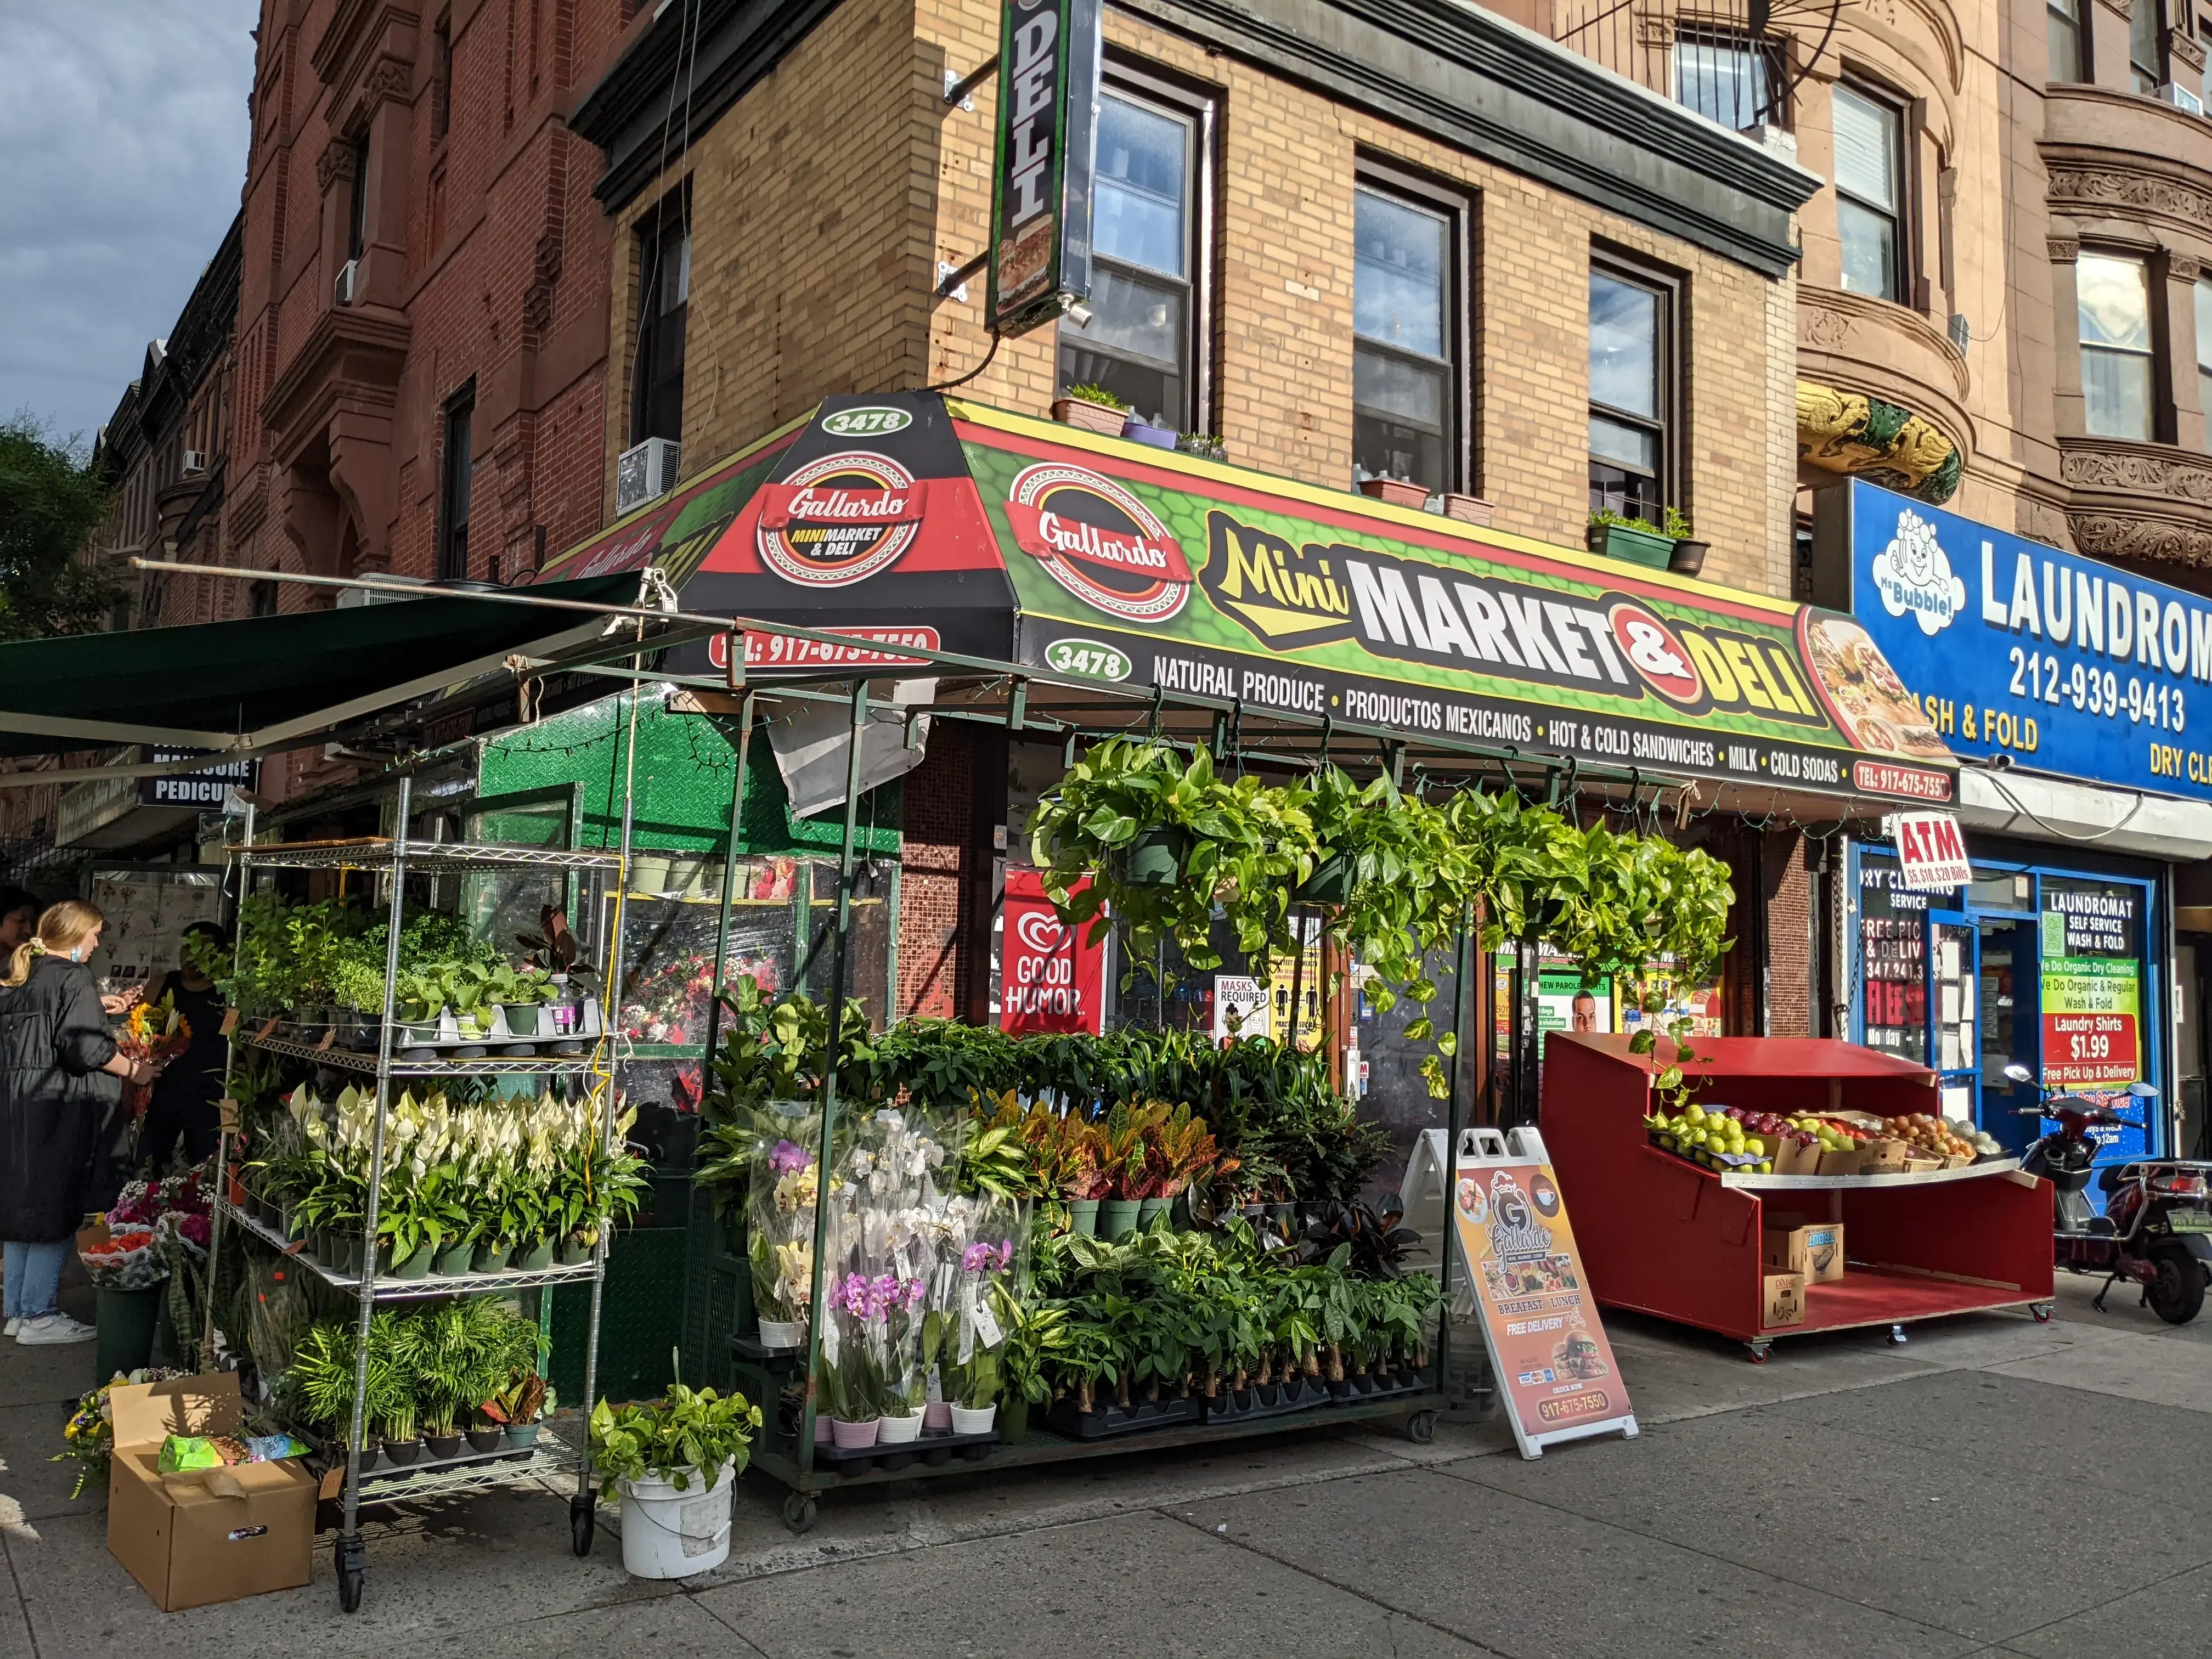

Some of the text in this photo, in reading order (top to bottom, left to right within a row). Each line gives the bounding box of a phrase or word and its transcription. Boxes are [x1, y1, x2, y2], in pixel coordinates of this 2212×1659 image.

[1012, 10, 1058, 228] DELI
[832, 409, 900, 432] 3478
[788, 486, 909, 522] Gallardo
[810, 541, 856, 557] & DELI
[1038, 512, 1167, 569] Gallardo
[1881, 576, 1892, 589] Ms
[1893, 581, 1952, 621] Bubble!
[1981, 540, 2212, 680] LAUNDROM
[1217, 527, 1818, 718] Mini MARKET & DELI
[720, 634, 763, 663] TL:
[1054, 646, 1121, 678] 3478
[2009, 647, 2185, 733] 212-939-9413
[1154, 656, 1838, 784] NATURAL PRODUCE PRODUCTOS MEXICANOS HOT & COLD SANDWICHES MILK COLD SODAS
[1913, 693, 2038, 752] SH & FOLD
[2150, 743, 2183, 778] DRY
[1859, 766, 1878, 788] TEL:
[156, 780, 245, 802] PEDICUR
[1901, 820, 1964, 864] ATM
[1951, 866, 1969, 880] Bills
[1890, 893, 1927, 910] SERVICE
[2051, 893, 2133, 918] LAUNDROMAT
[1861, 919, 1921, 940] REE PIC
[2069, 916, 2123, 933] SELF SERVICE
[1866, 940, 1876, 958] &
[2067, 932, 2125, 950] WASH & FOLD
[1017, 956, 1072, 985] GOOD
[2051, 962, 2062, 972] Do
[2064, 961, 2091, 974] Organic
[2092, 962, 2104, 975] Dry
[2106, 962, 2135, 975] Cleaning
[1221, 980, 1252, 991] MASKS
[1538, 981, 1554, 990] NEW
[1555, 982, 1581, 990] PAROLE
[2053, 979, 2065, 991] Do
[2067, 979, 2098, 994] Organic
[2100, 980, 2106, 992] &
[2107, 980, 2136, 995] Regular
[1221, 991, 1266, 1003] REQUIRED
[2064, 996, 2113, 1009] Wash & Fold
[2055, 1016, 2123, 1035] Laundry Shirts
[1867, 1029, 1900, 1047] Monday
[2070, 1034, 2109, 1062] $1.99
[2042, 1065, 2135, 1081] Free Pick Up & Delivery
[2102, 1133, 2119, 1144] 12am
[1486, 1223, 1551, 1273] Gallardo
[1807, 1231, 1836, 1248] TROUT
[1497, 1299, 1544, 1316] BREAFAST
[1550, 1294, 1582, 1308] LUNCH
[1506, 1317, 1564, 1336] FREE DELIVERY
[1553, 1383, 1583, 1395] ORDER NOW
[1542, 1393, 1605, 1418] 917-675-7550
